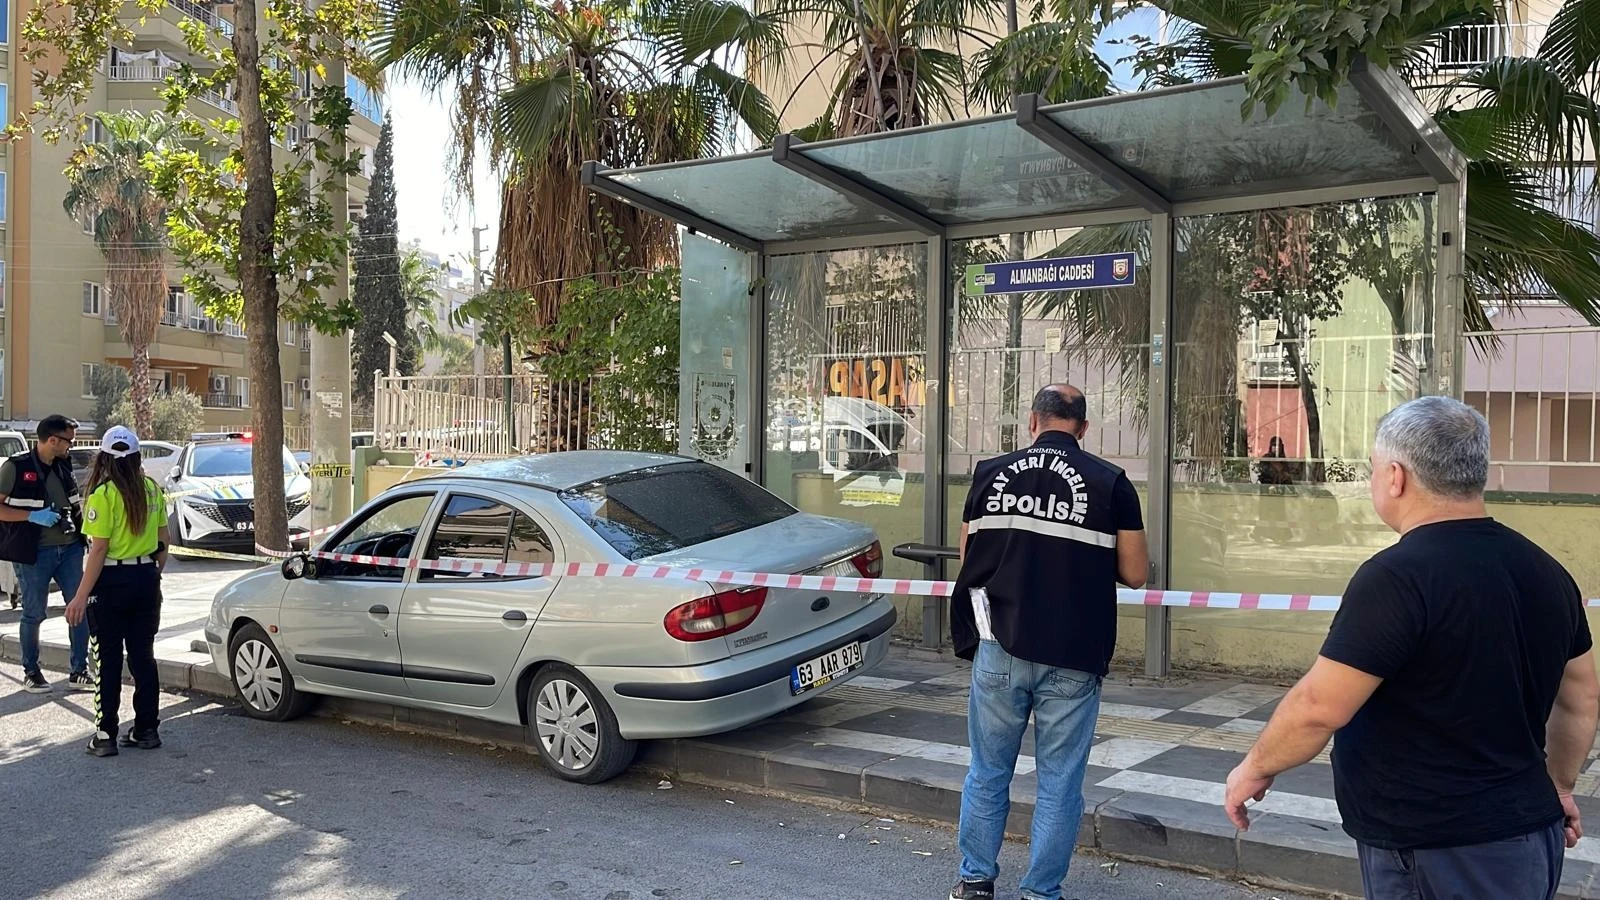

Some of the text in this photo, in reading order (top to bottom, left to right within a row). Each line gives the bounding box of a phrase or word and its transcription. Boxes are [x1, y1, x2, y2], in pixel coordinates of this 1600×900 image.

[1010, 263, 1057, 285] ALMANBAĞI
[1059, 260, 1095, 281] CADDESİ
[986, 453, 1088, 524] OLAY YERİ İNCELEME
[1002, 493, 1070, 521] POLİS
[237, 521, 247, 530] 63
[799, 663, 814, 685] 63
[820, 653, 840, 677] AAR
[842, 644, 860, 666] 879
